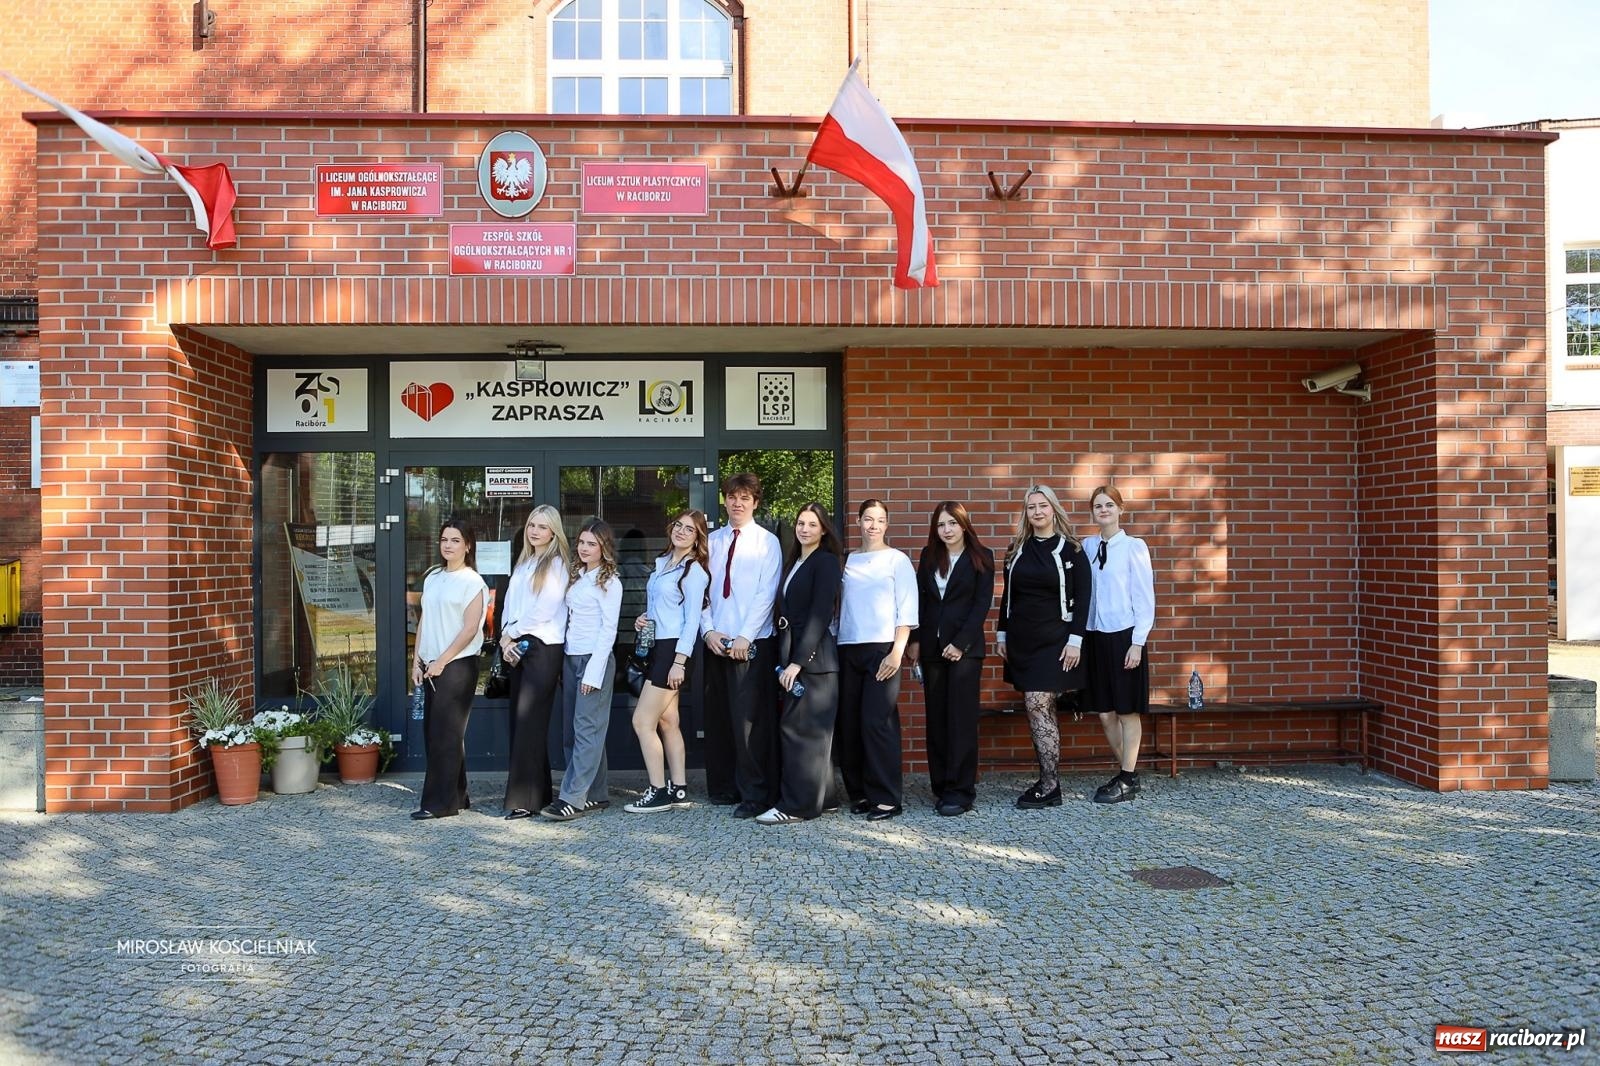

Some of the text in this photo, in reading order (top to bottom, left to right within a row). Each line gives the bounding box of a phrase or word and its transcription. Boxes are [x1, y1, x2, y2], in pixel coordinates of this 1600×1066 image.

[320, 170, 438, 184] I LICEUM OGÓLNOKSZTAŁCĄCE
[586, 175, 701, 187] LICEUM SZTUK PLASTYCZNYCH
[330, 186, 427, 197] IM. JANA KASPROWICZA
[616, 191, 671, 202] W RACIBORZU
[351, 200, 407, 211] W RACIBORZU
[482, 229, 543, 241] ZESPÓŁ SZKÓŁ
[453, 243, 572, 257] OGÓLNOKSZTAŁCĄCYCH NR 1
[483, 260, 543, 270] W RACIBORZU
[491, 405, 604, 421] ZAPRASZA
[762, 403, 790, 416] LSP
